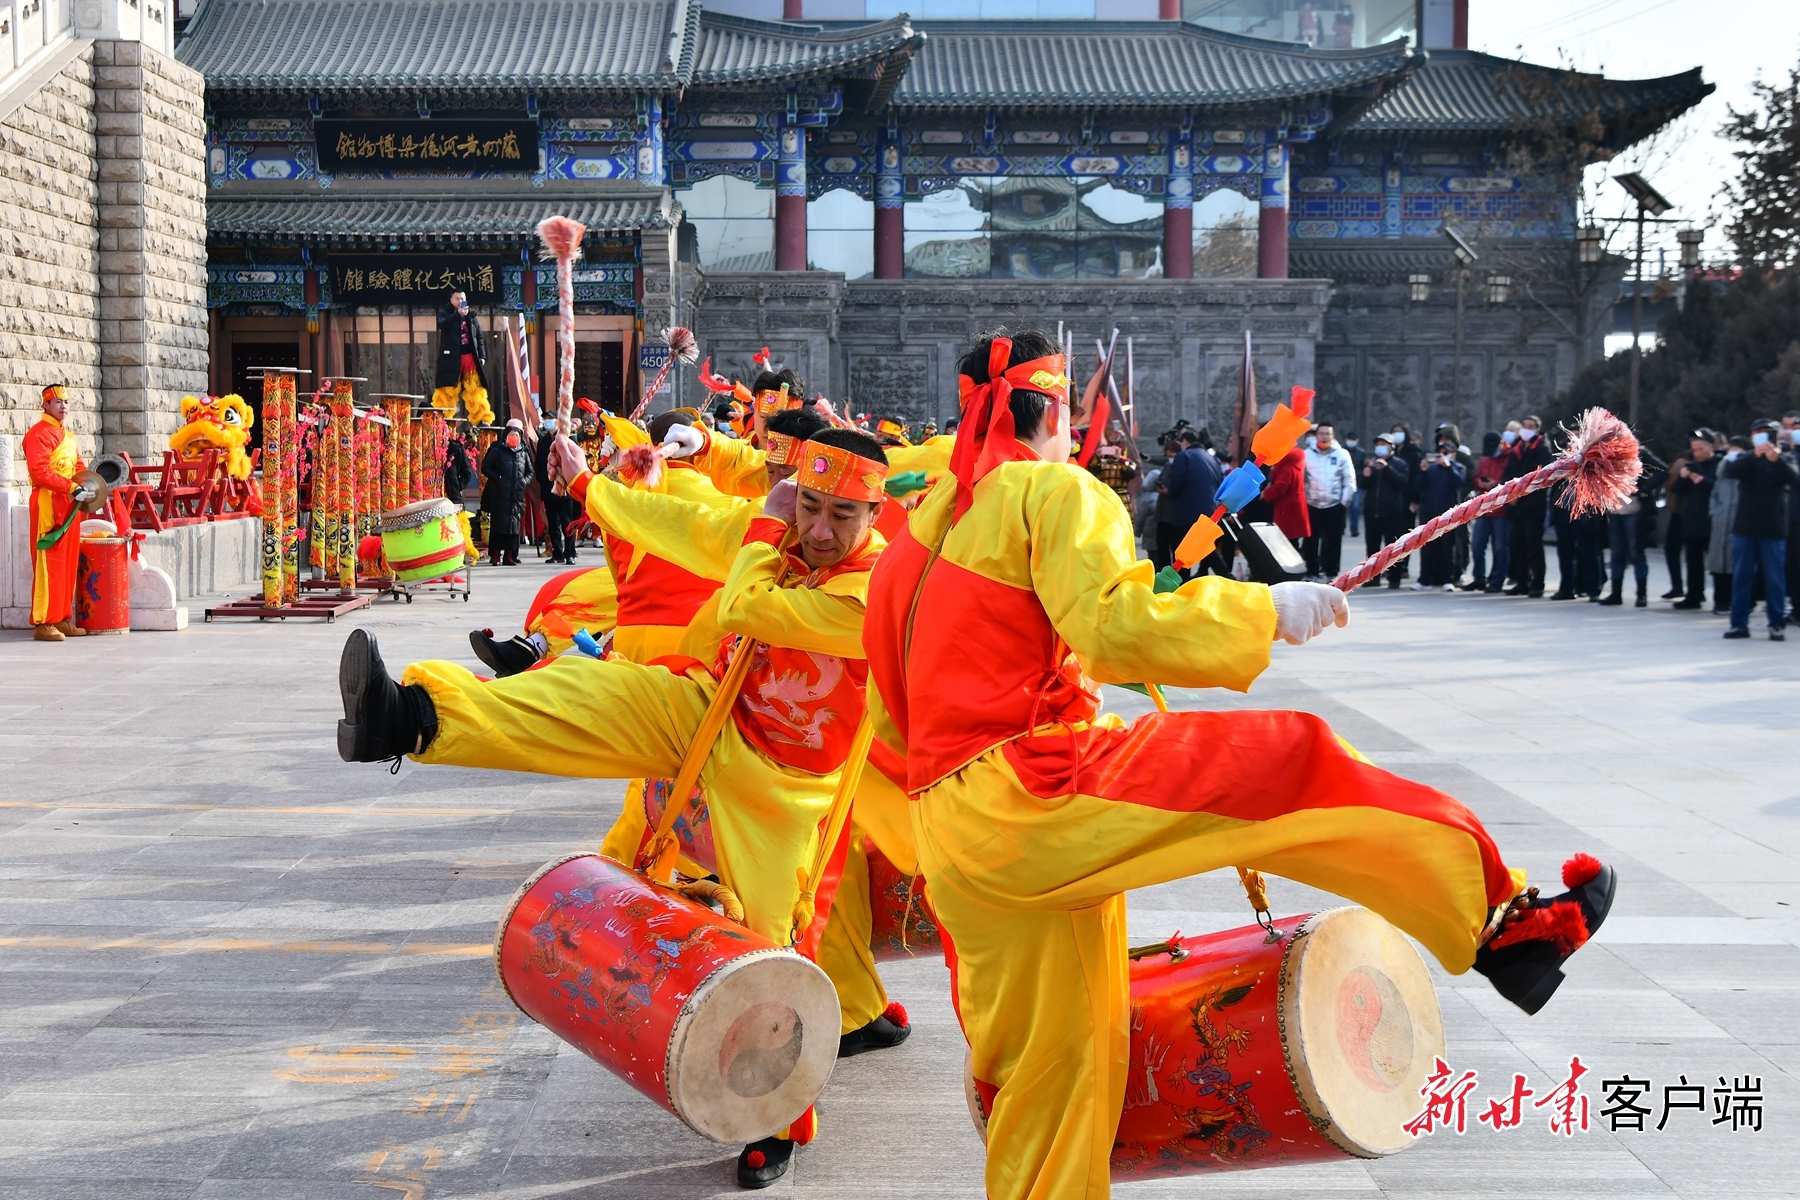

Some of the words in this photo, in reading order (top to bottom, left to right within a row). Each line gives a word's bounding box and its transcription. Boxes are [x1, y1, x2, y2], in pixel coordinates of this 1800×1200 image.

[642, 347, 671, 355] 北滨河中
[641, 356, 663, 368] 450
